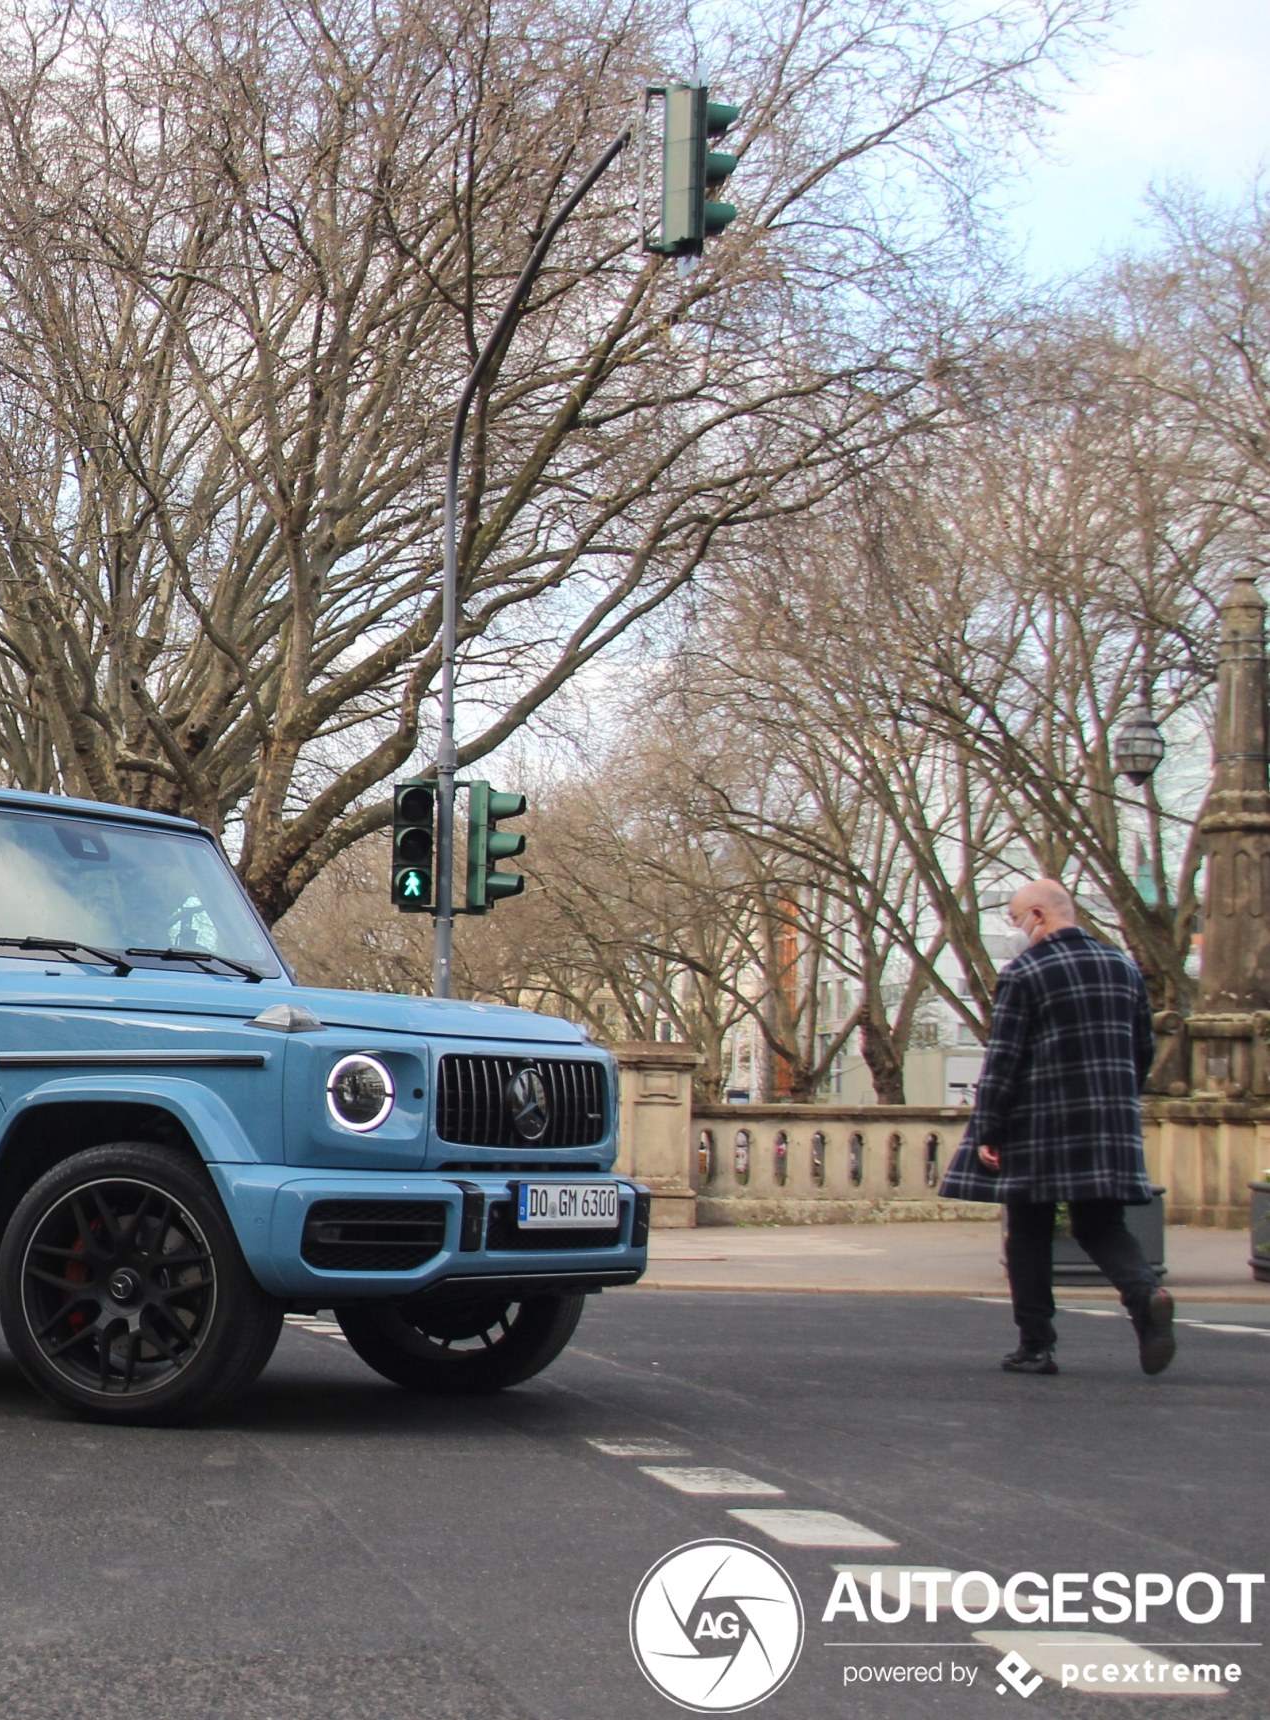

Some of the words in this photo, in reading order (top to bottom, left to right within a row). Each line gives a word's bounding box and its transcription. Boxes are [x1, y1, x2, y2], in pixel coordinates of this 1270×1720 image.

[529, 1188, 548, 1217] DO
[559, 1188, 577, 1217] GM
[582, 1189, 615, 1217] 6300
